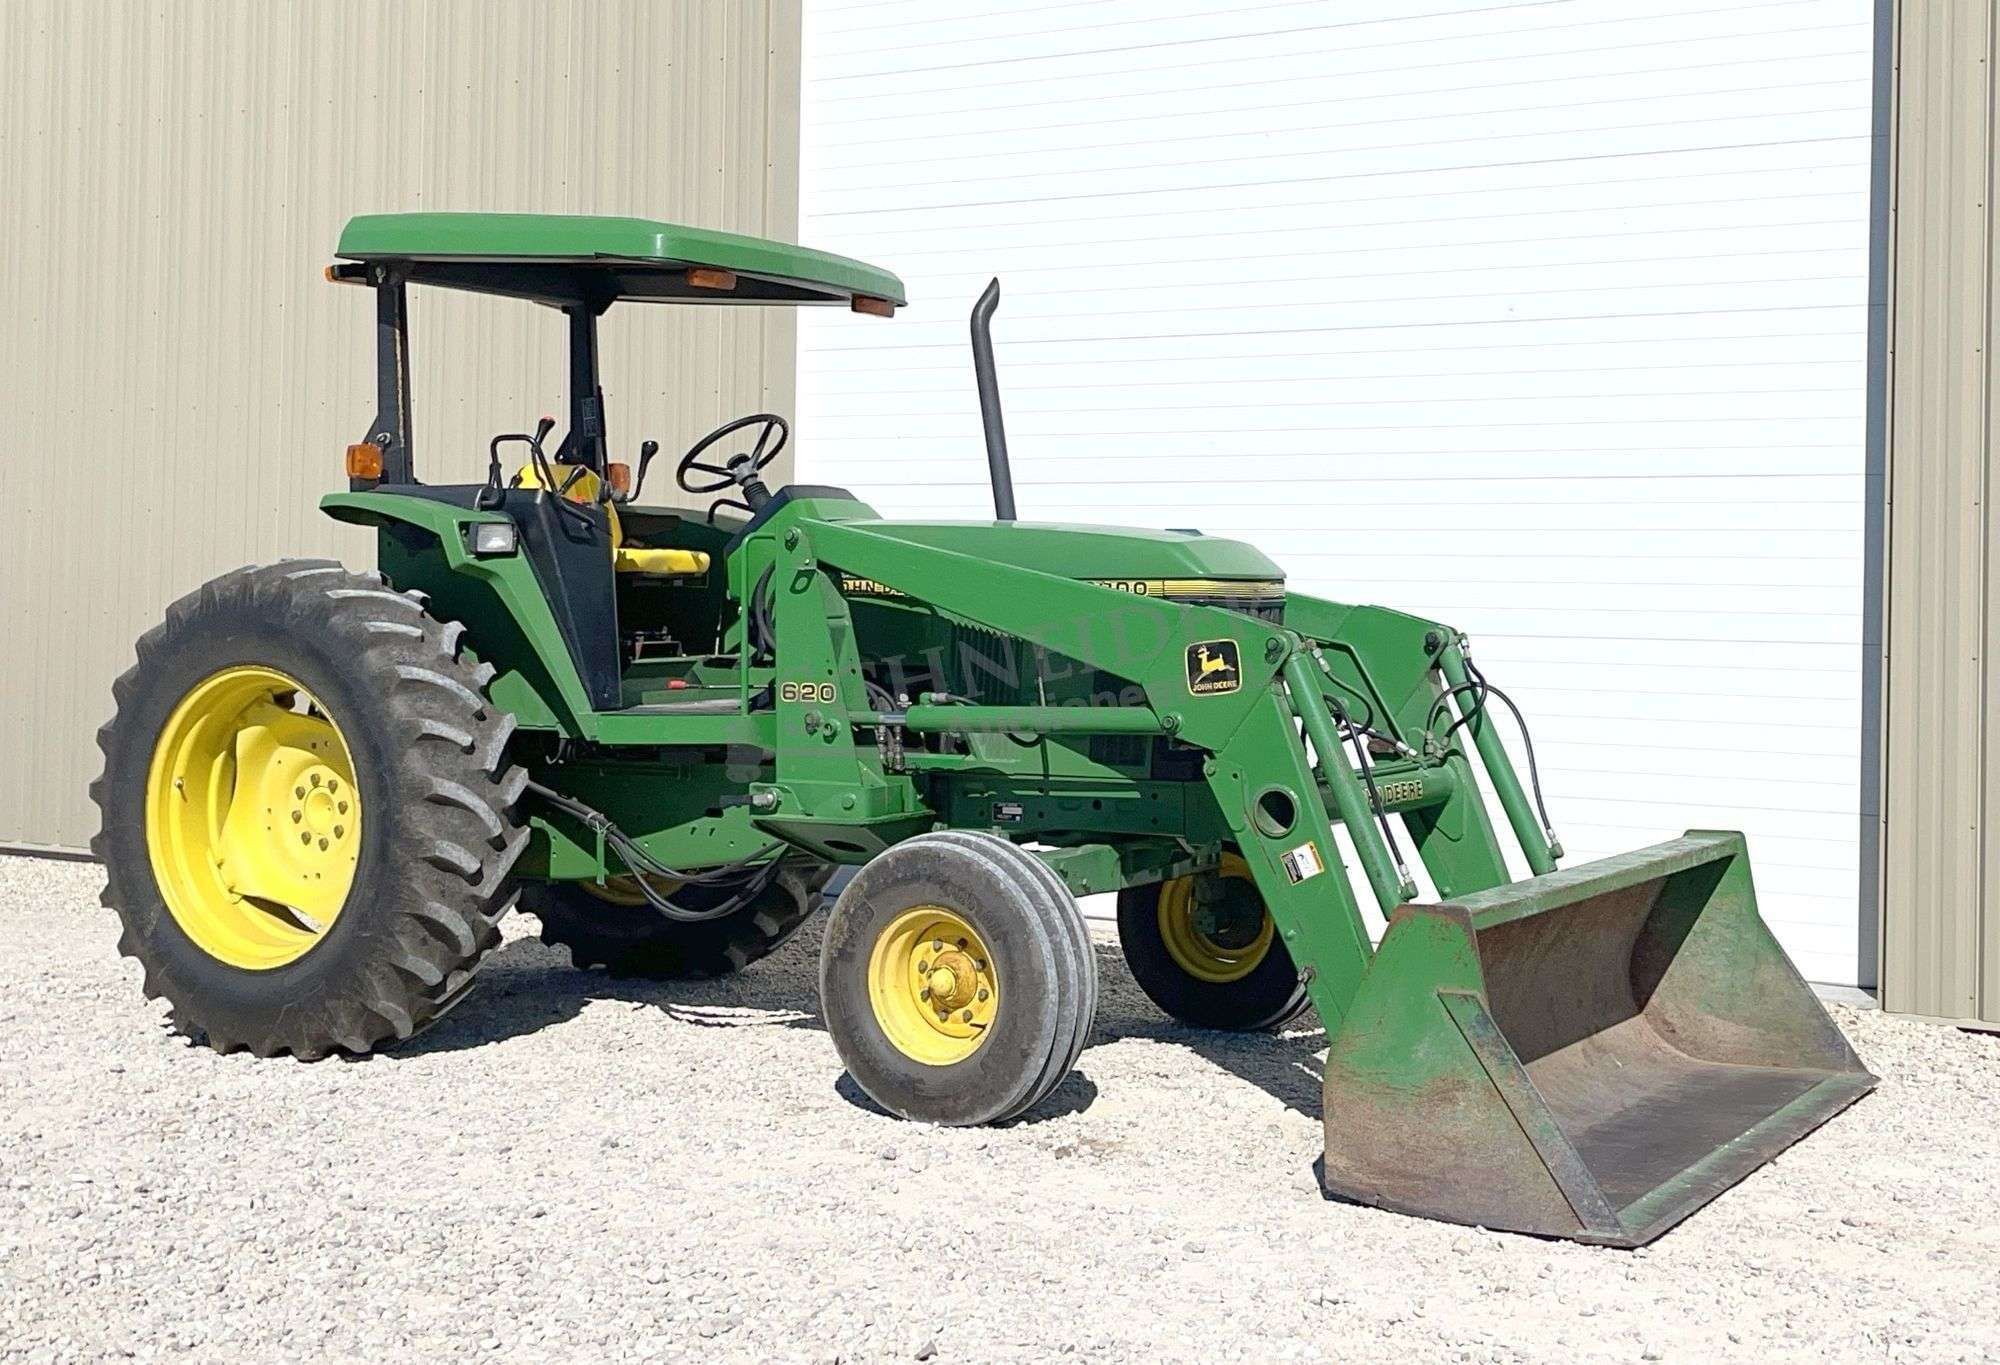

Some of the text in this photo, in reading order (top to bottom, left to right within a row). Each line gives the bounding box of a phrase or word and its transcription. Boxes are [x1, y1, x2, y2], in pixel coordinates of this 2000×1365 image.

[781, 682, 837, 704] 620
[1193, 680, 1238, 692] JOHN DEERE
[1384, 780, 1424, 805] DEERE
